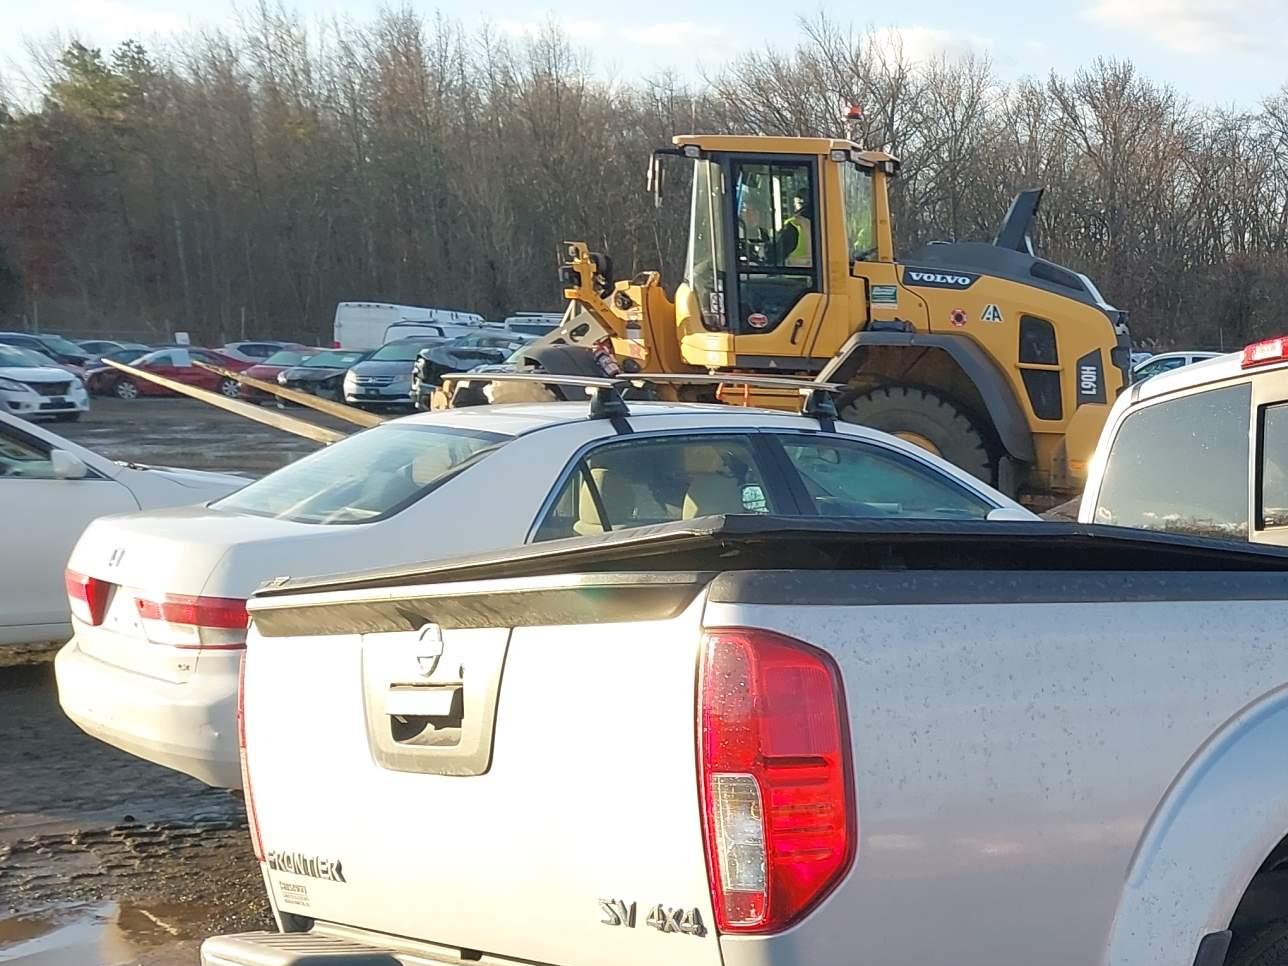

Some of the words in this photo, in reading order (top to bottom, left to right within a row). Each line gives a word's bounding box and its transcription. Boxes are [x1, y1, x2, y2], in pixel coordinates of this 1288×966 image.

[908, 271, 971, 286] VOLVO
[1080, 366, 1097, 395] L90H
[267, 851, 347, 883] FRONTIER
[599, 898, 637, 928] SV
